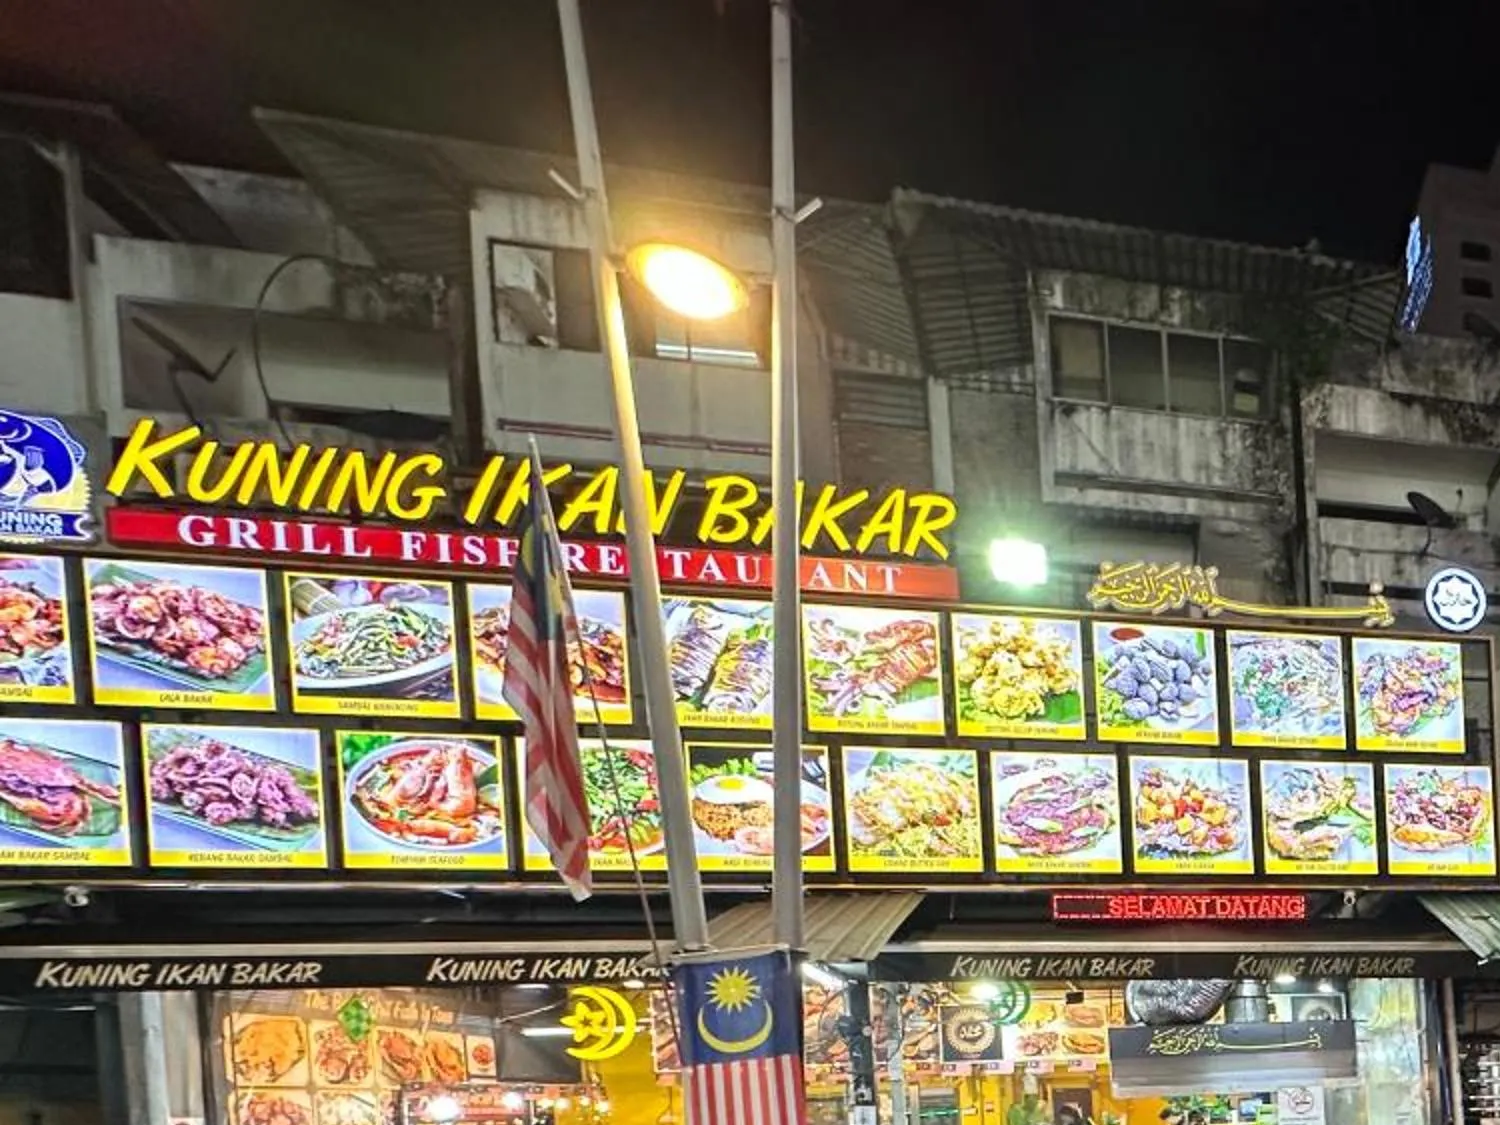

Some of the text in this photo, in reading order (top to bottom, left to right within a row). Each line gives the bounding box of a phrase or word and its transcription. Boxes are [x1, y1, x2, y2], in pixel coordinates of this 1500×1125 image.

[107, 417, 447, 520] KUNING
[178, 514, 372, 559] GRILL
[560, 543, 905, 595] RETAUANT
[1108, 898, 1302, 916] SELAMAT DATANG
[35, 961, 323, 988] KUNING IKAN BAKAR
[426, 957, 525, 983] KUNING
[530, 958, 591, 981] IKAN
[949, 954, 1156, 977] KUNING IKAN BAKAR
[1233, 954, 1416, 977] KUNING IKAN BAKAR
